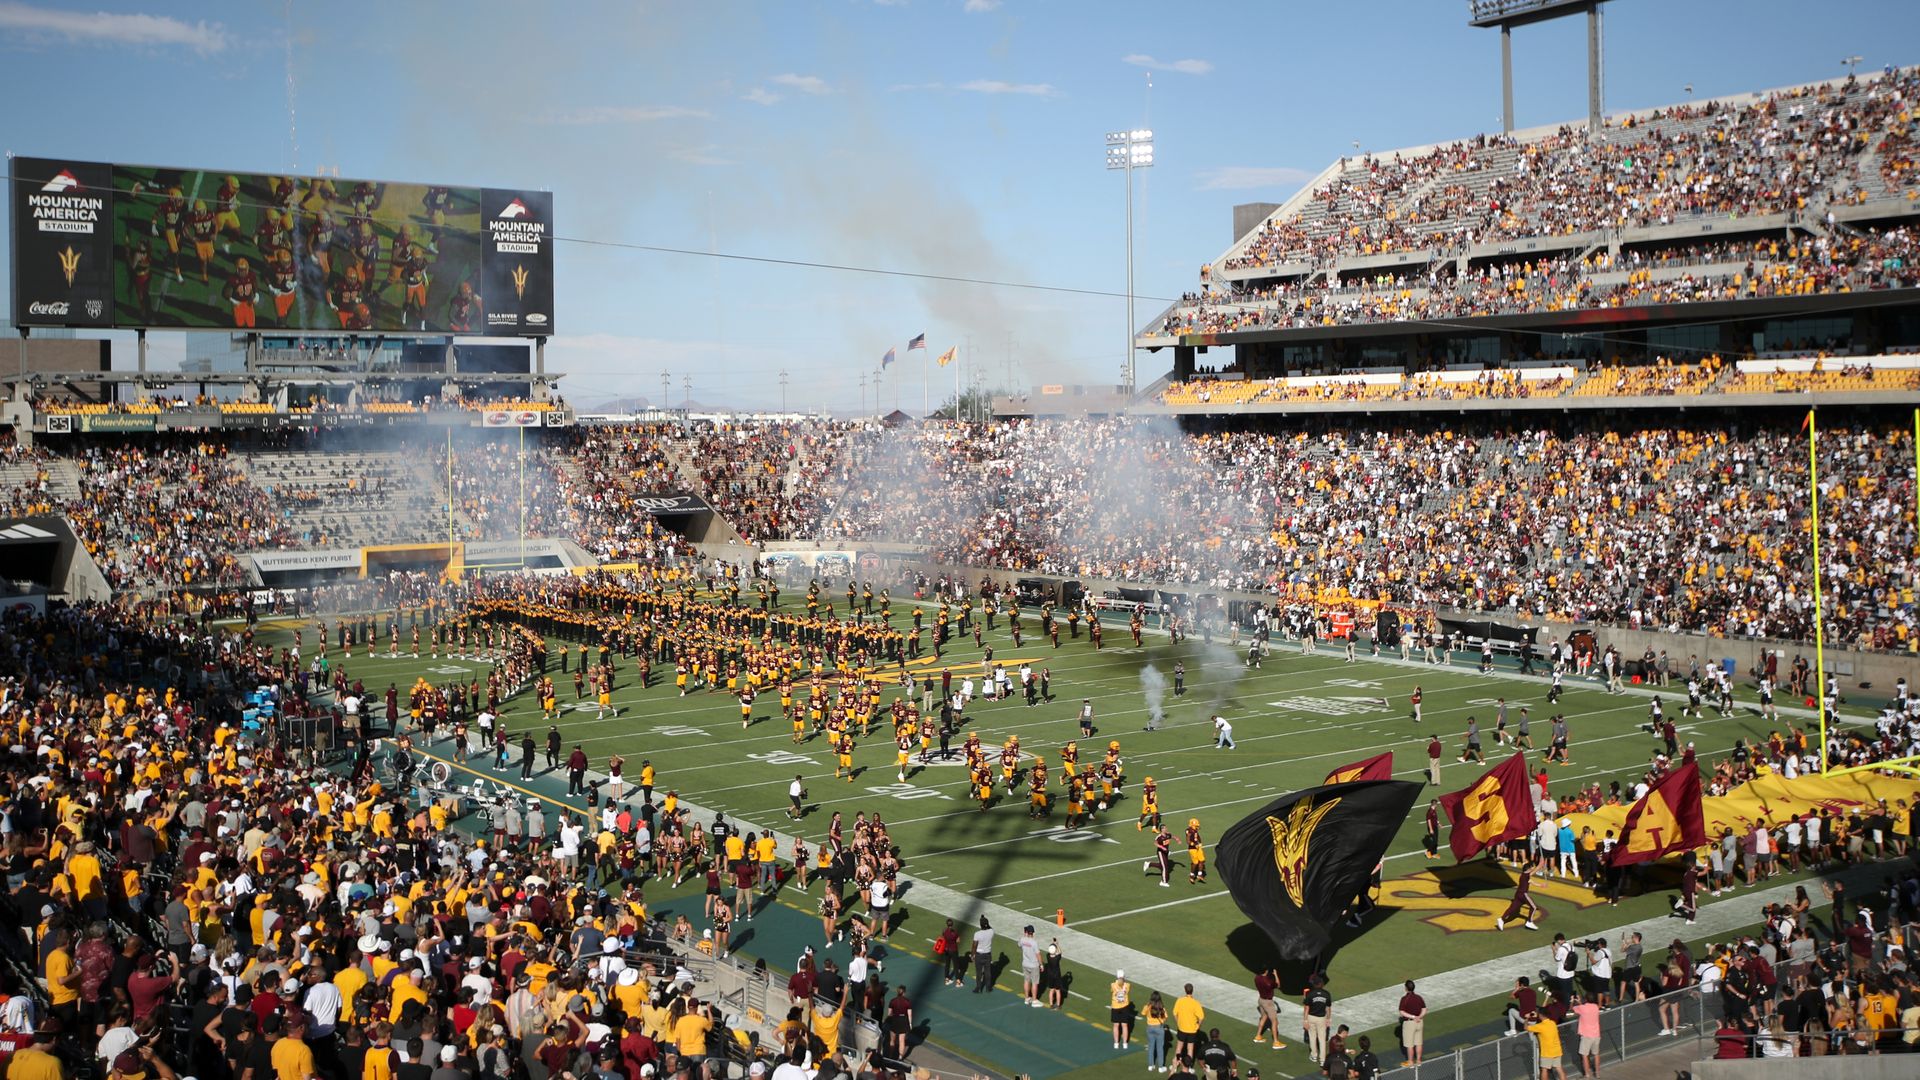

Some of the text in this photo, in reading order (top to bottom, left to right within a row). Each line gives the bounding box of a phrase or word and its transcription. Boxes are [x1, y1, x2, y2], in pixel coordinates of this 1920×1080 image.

[29, 194, 103, 210] MOUNTAIN
[33, 206, 98, 221] AMERICA
[44, 222, 88, 231] STADIUM
[489, 220, 544, 233] MOUNTAIN
[493, 232, 541, 243] AMERICA
[526, 544, 552, 552] FACILITY
[262, 554, 352, 566] BUTTERFIELD KENT FURST
[746, 750, 813, 765] 30
[864, 783, 943, 800] 20
[1463, 775, 1510, 843] S
[1628, 788, 1684, 855] A
[1872, 1000, 1882, 1014] 13
